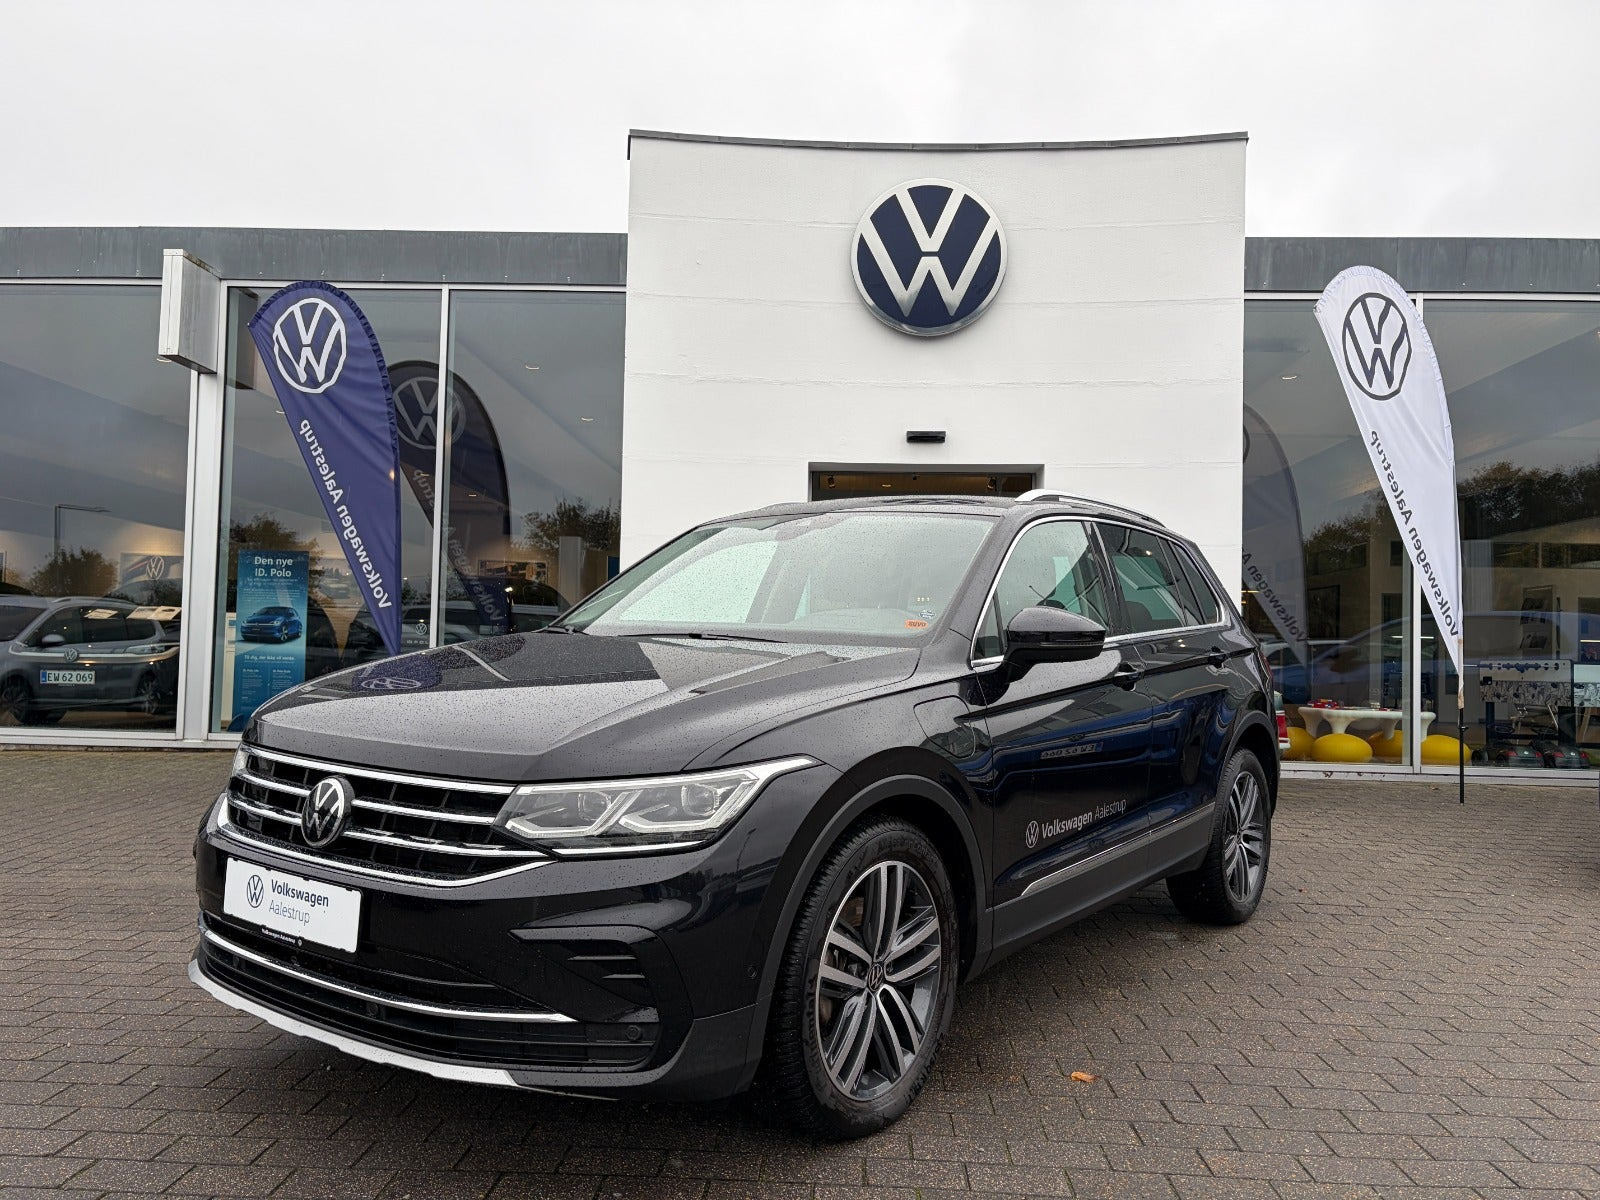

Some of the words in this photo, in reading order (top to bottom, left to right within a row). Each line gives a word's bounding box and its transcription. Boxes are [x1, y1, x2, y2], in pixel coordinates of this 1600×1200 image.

[851, 178, 1008, 337] VW
[254, 556, 273, 566] Den
[275, 558, 293, 568] nye
[255, 568, 268, 578] ID.
[270, 568, 292, 578] Polo
[47, 672, 60, 682] EW
[61, 672, 73, 682] 62
[75, 673, 94, 683] 069
[1041, 811, 1093, 839] Volkswagen
[1094, 799, 1127, 821] Aalestrup
[271, 879, 329, 908] Volkswagen
[269, 900, 310, 926] Aalestrup
